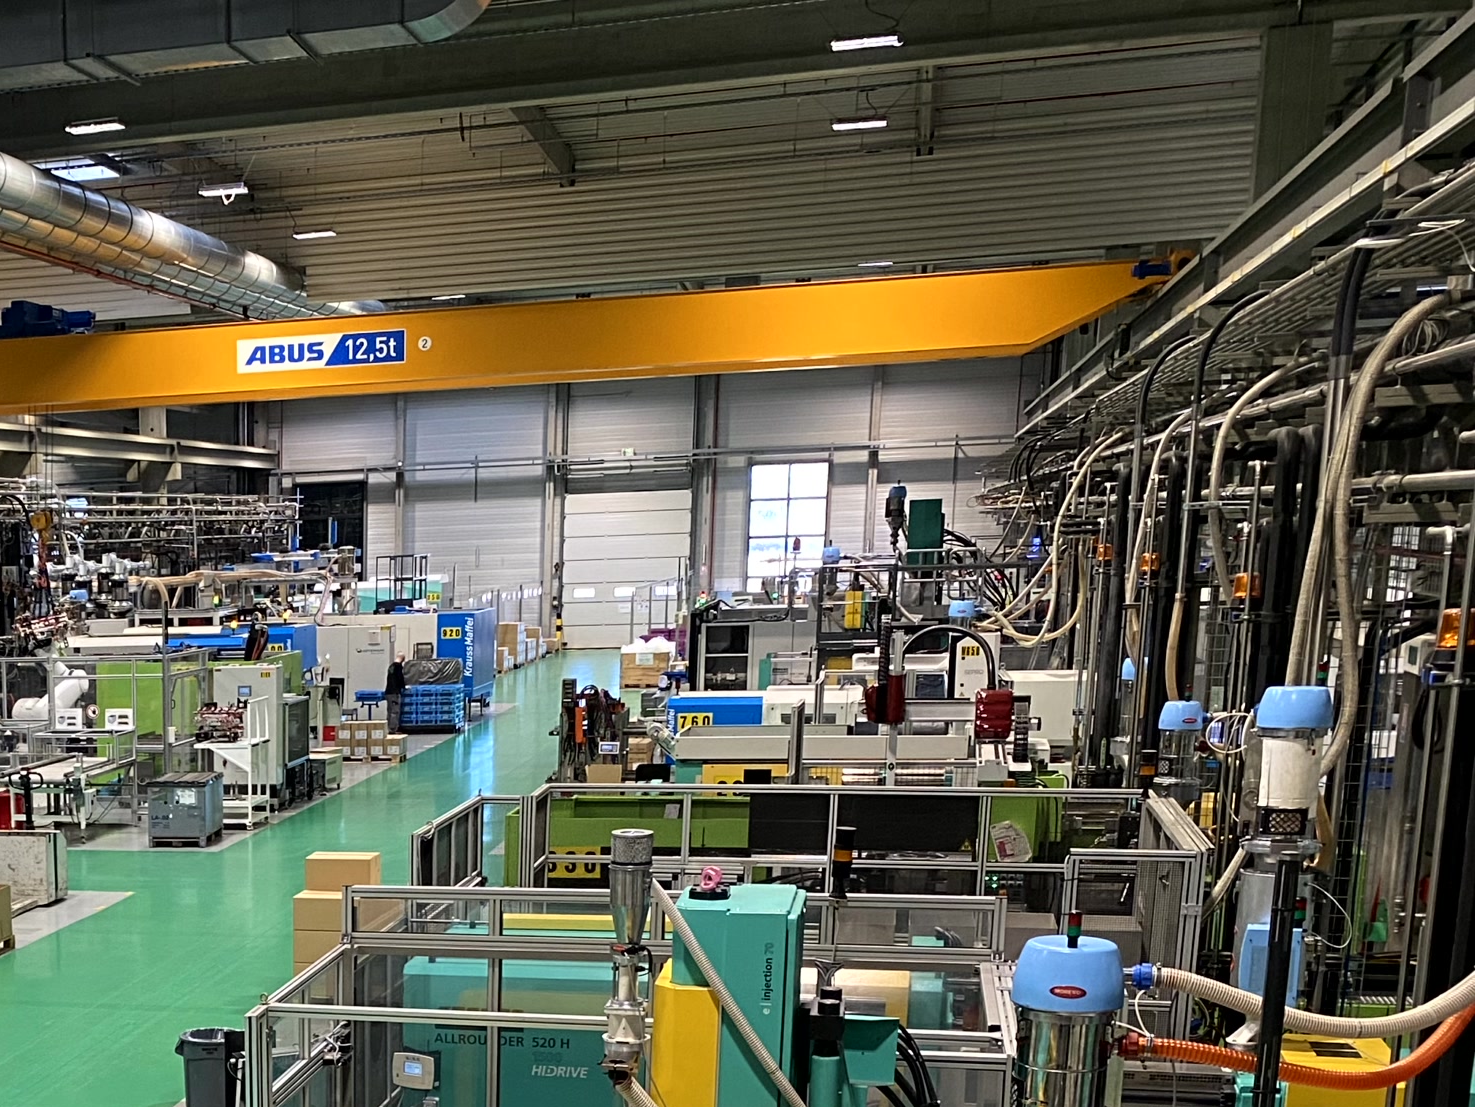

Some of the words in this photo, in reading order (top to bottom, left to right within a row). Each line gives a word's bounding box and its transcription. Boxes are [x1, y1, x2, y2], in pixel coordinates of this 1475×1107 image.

[245, 341, 324, 366] ABUS
[345, 336, 397, 362] 12,5t
[421, 338, 429, 349] 2
[442, 628, 461, 638] 920
[761, 957, 774, 1001] injection
[434, 1032, 524, 1049] ALLROUDER
[531, 1036, 556, 1049] 520
[560, 1037, 570, 1049] H
